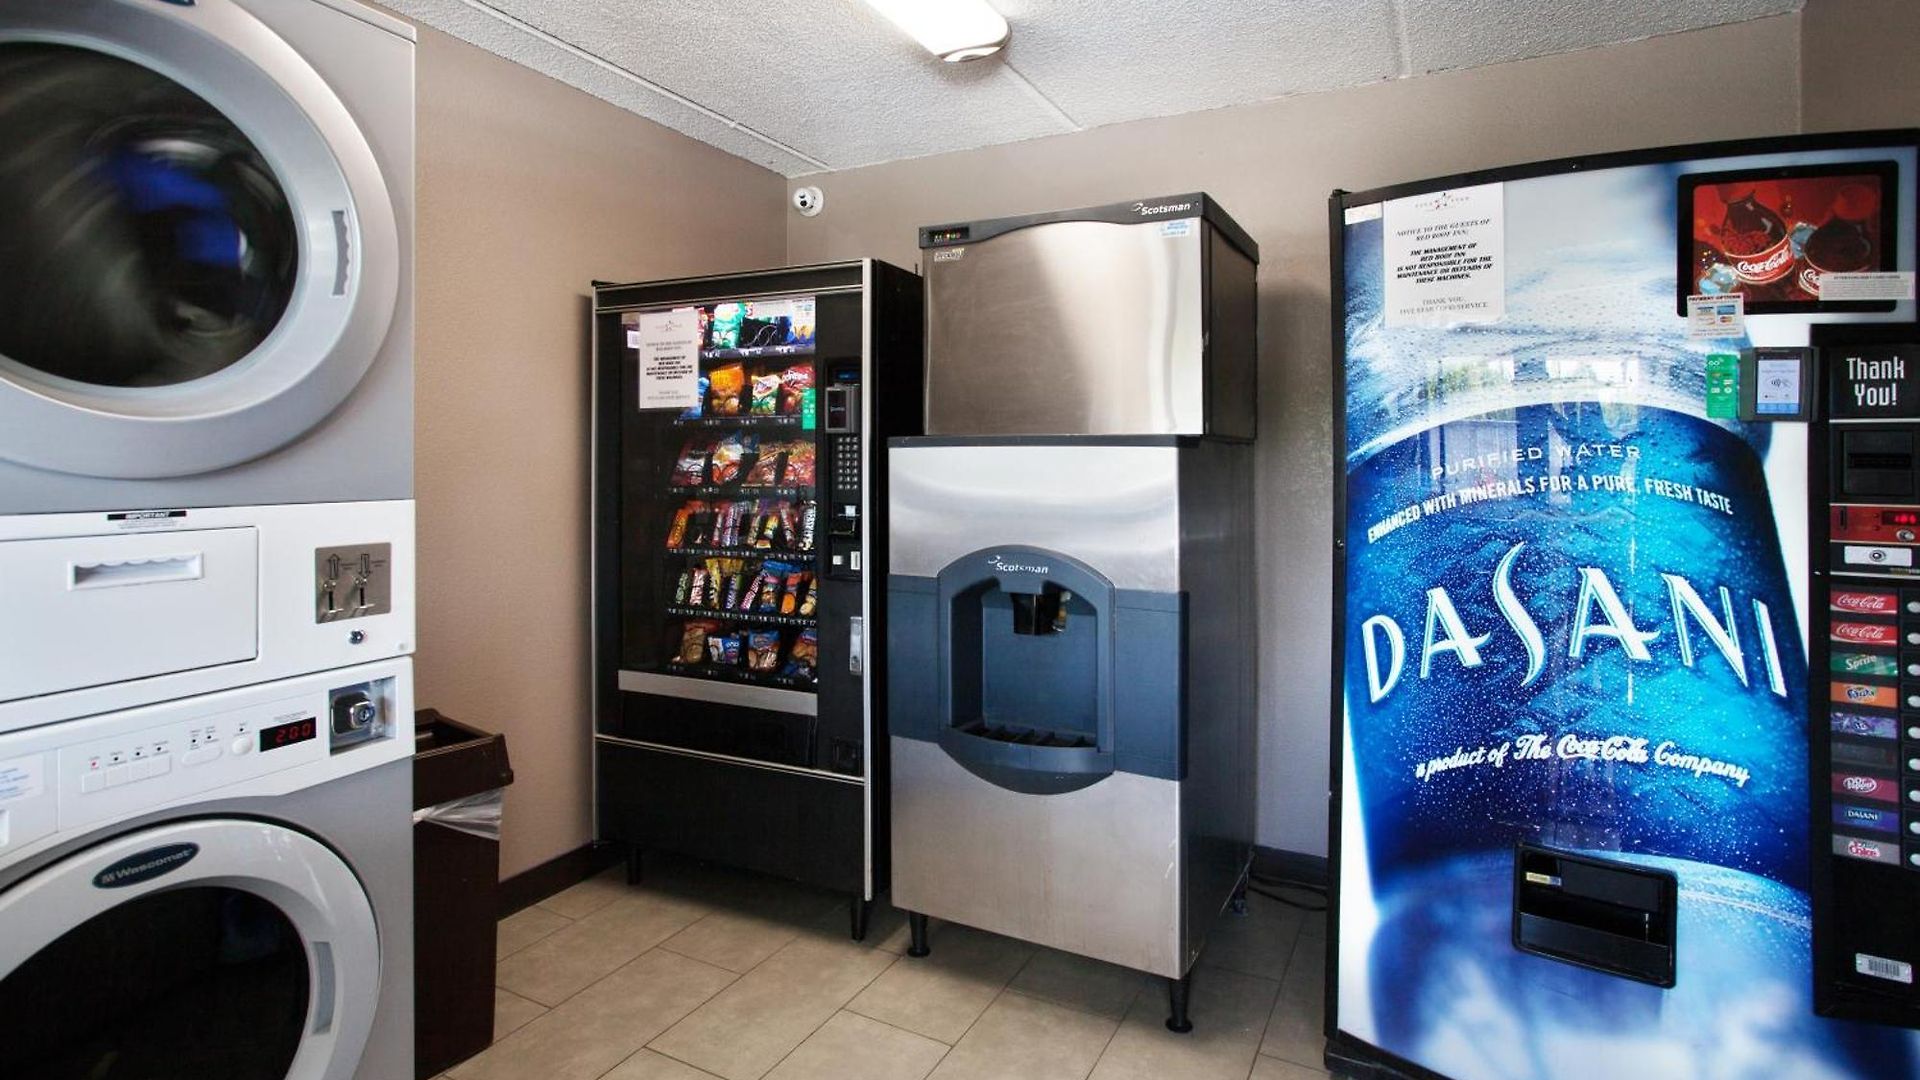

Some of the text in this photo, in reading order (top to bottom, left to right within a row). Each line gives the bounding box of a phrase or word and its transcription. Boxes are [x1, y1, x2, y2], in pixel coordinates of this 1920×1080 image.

[1141, 203, 1191, 216] Scotsman
[1410, 242, 1477, 257] THE MANAGEMENT OF
[1405, 264, 1417, 272] NOT
[1846, 355, 1904, 380] Thank
[1854, 383, 1897, 406] You!
[1432, 443, 1641, 480] PURIFIED WATER
[1367, 505, 1421, 544] ENHANCED
[1422, 492, 1457, 516] WITH
[1458, 477, 1535, 505] MINERALS
[1539, 474, 1573, 492] FOR
[1577, 474, 1589, 491] A
[1643, 478, 1694, 502] FRESH
[1694, 487, 1735, 515] TASTE
[996, 562, 1049, 574] Scotsman
[1361, 541, 1788, 704] DASANI
[1845, 654, 1877, 671] Sprite
[1424, 746, 1487, 783] product
[1487, 742, 1510, 768] of
[1513, 733, 1552, 760] The
[1557, 733, 1650, 763] Coca-Cola
[1654, 740, 1751, 788] Company
[115, 848, 193, 879] Wascomat
